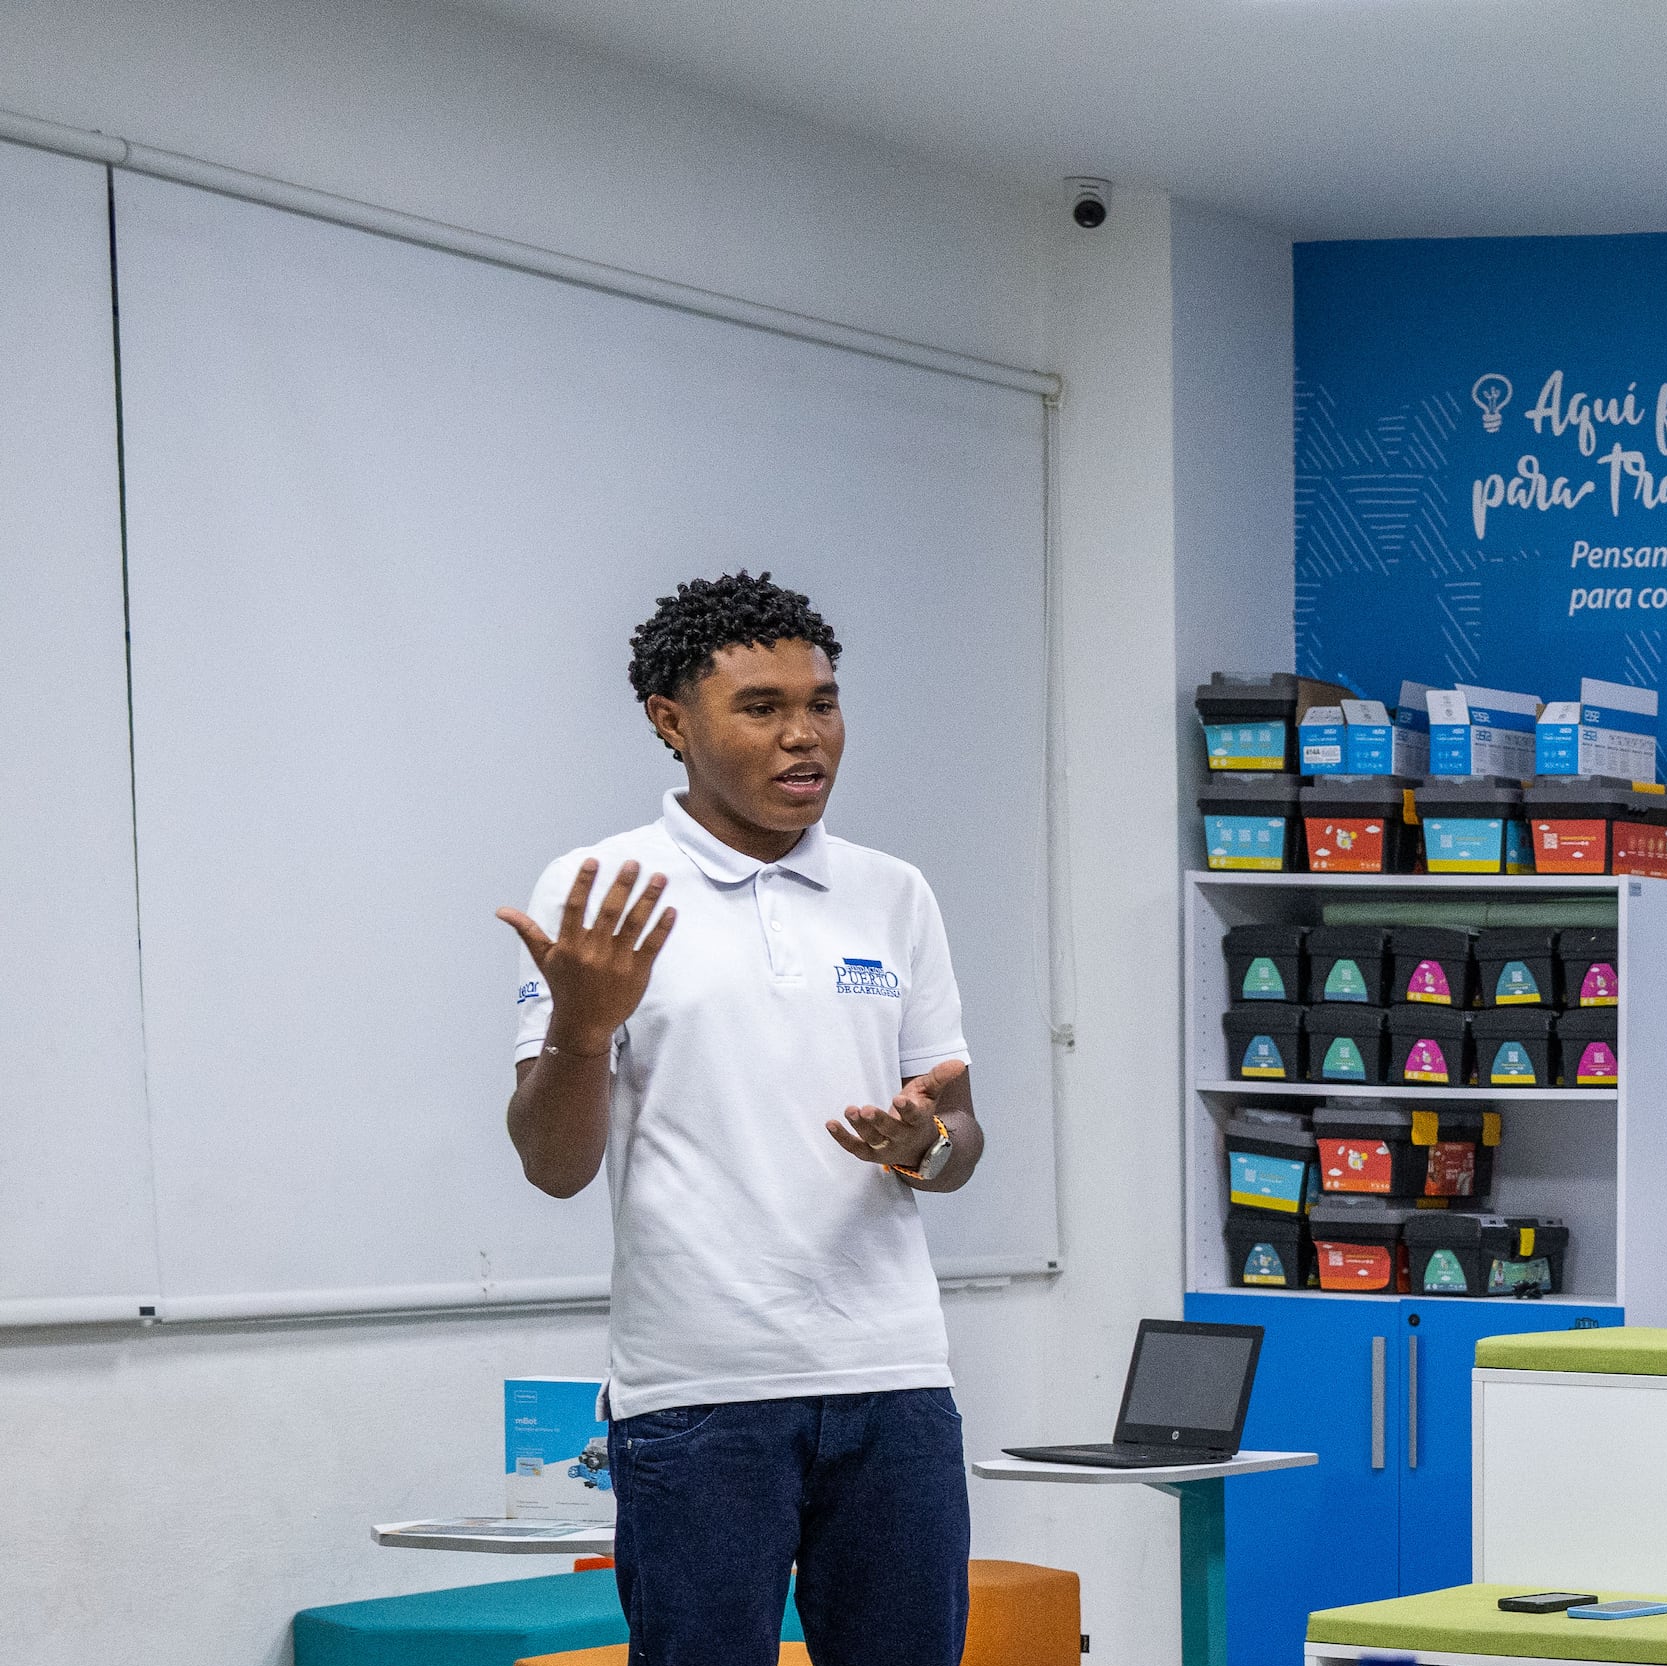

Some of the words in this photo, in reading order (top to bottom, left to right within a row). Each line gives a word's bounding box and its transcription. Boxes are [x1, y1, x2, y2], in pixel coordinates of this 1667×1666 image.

[1525, 370, 1645, 456] Aquí
[1471, 454, 1595, 540] para
[1568, 588, 1632, 617] para
[833, 965, 898, 989] PUERTO
[836, 985, 852, 994] DE
